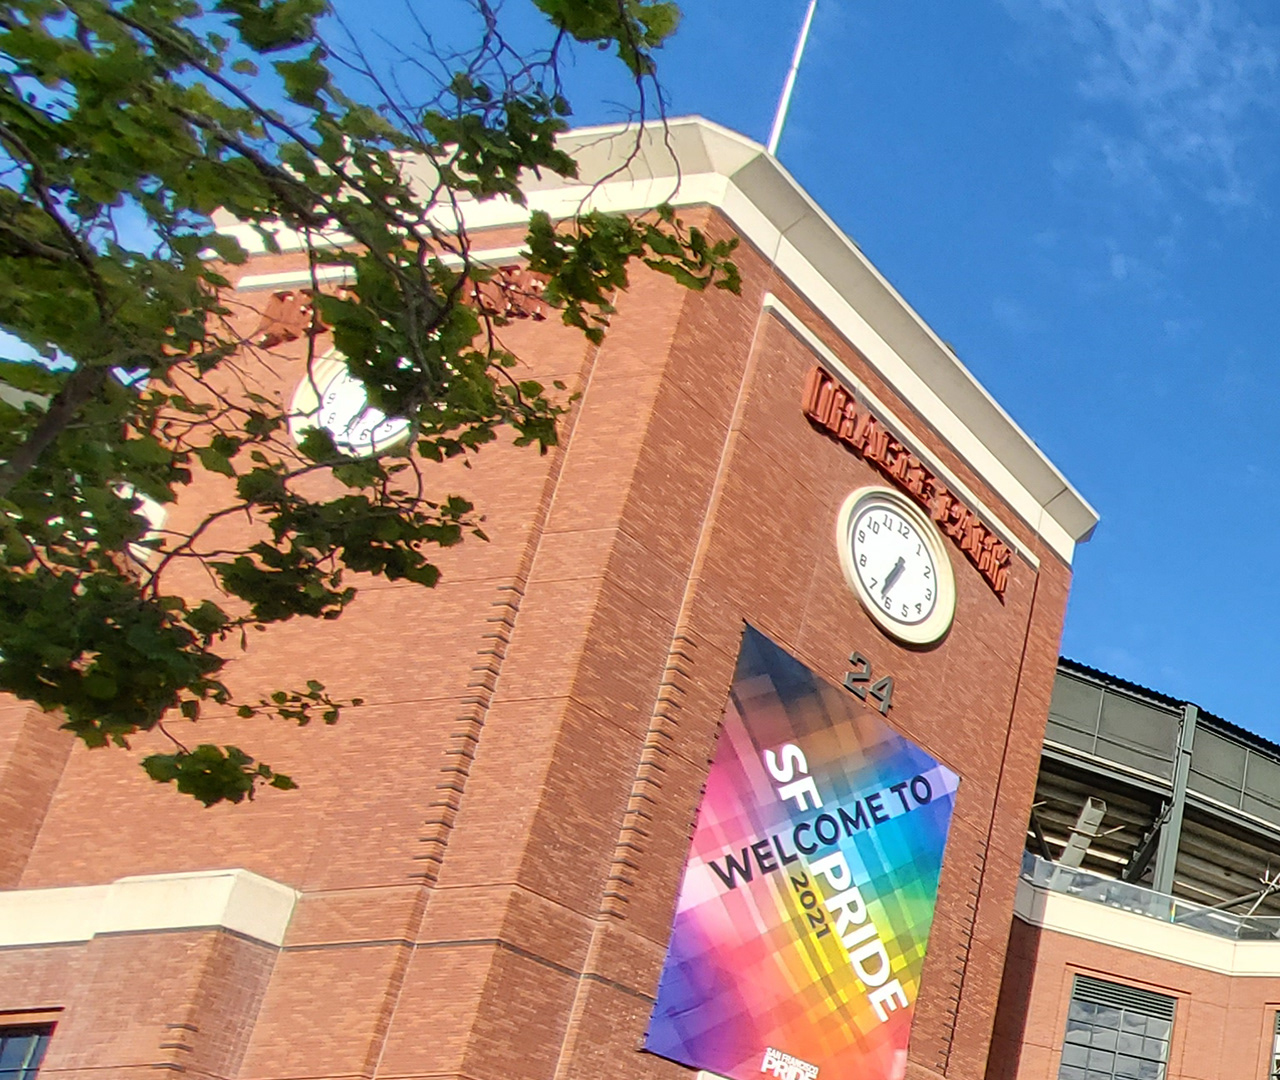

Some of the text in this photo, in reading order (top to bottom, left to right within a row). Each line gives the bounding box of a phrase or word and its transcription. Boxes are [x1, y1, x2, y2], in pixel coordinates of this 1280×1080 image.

[867, 516, 880, 534] 10
[882, 514, 893, 531] 11
[857, 530, 866, 543] 9
[897, 521, 910, 539] 12
[916, 543, 922, 556] 1
[859, 554, 867, 567] 8
[923, 566, 931, 579] 2
[869, 577, 878, 590] 7
[925, 588, 932, 601] 3
[884, 596, 892, 610] 6
[914, 602, 922, 615] 4
[901, 604, 909, 618] 5
[842, 651, 893, 714] 24
[709, 774, 932, 889] WELCOME TO
[763, 743, 908, 1022] SF PRIDE
[790, 870, 831, 938] 2021
[766, 1047, 819, 1075] SAN FRANCISCO
